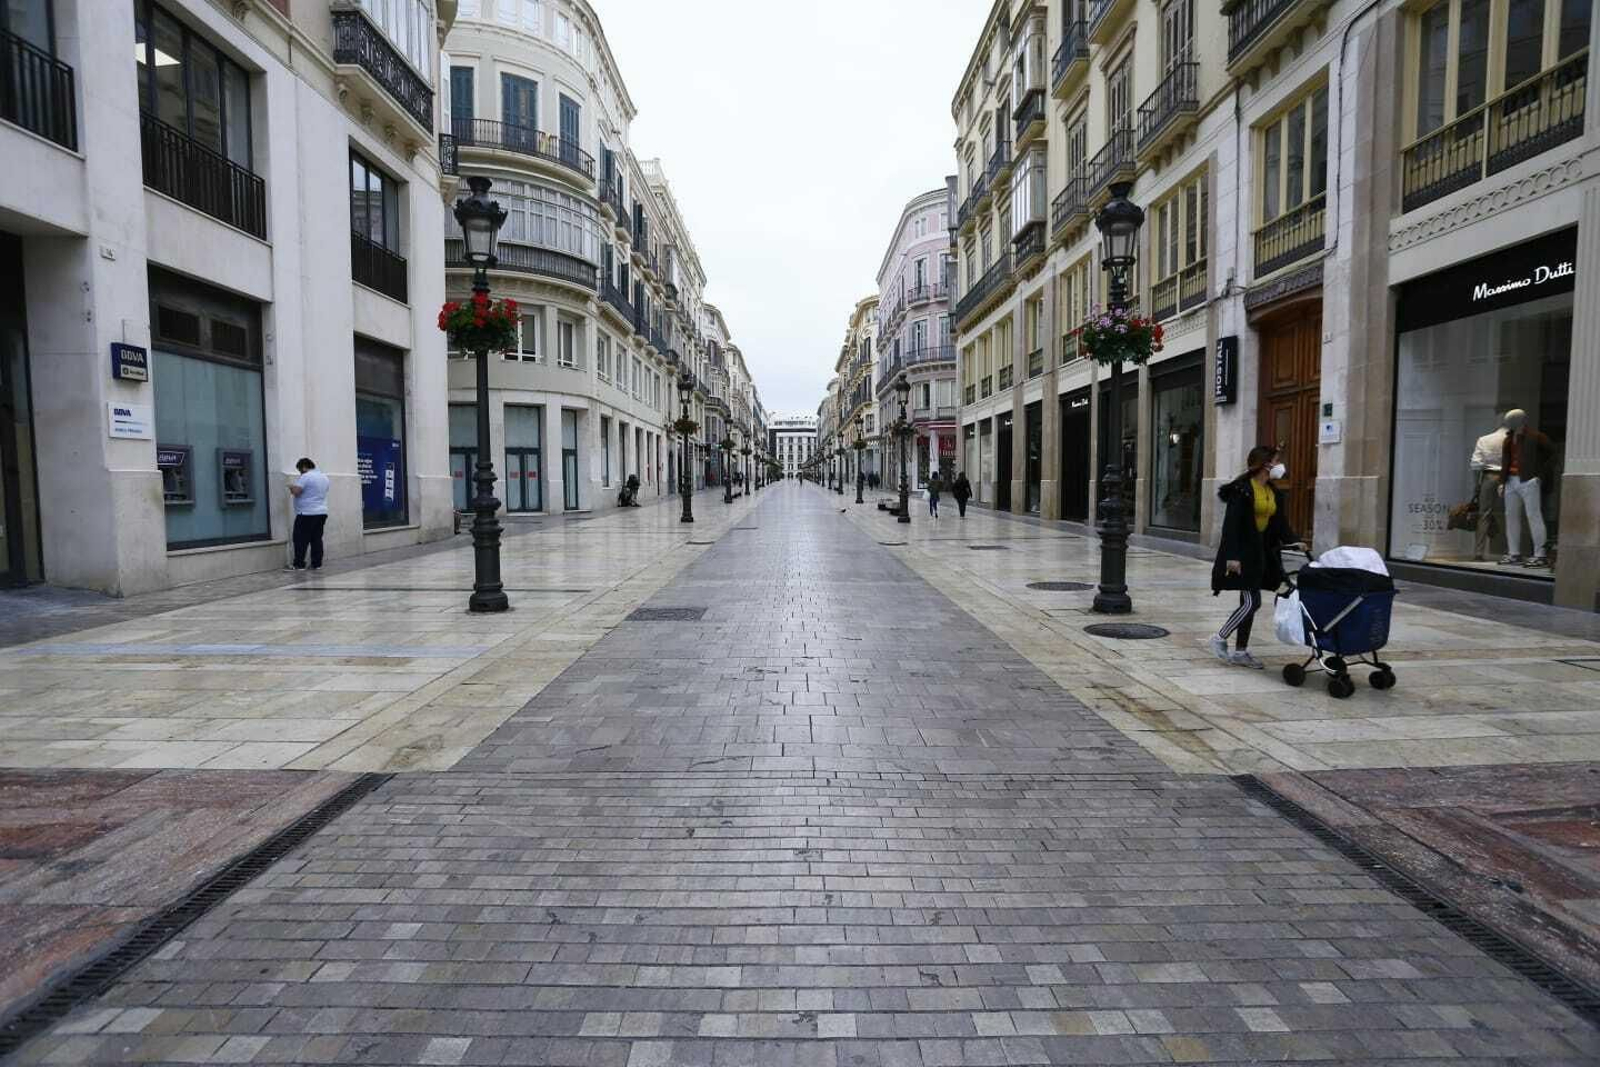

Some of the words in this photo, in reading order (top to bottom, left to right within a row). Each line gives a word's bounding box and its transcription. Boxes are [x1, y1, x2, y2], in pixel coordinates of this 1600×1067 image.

[1472, 278, 1531, 301] Massimo
[1534, 262, 1576, 285] Dutti
[121, 349, 144, 363] BBVA
[114, 408, 131, 417] BBVA
[1408, 503, 1450, 514] SEASON
